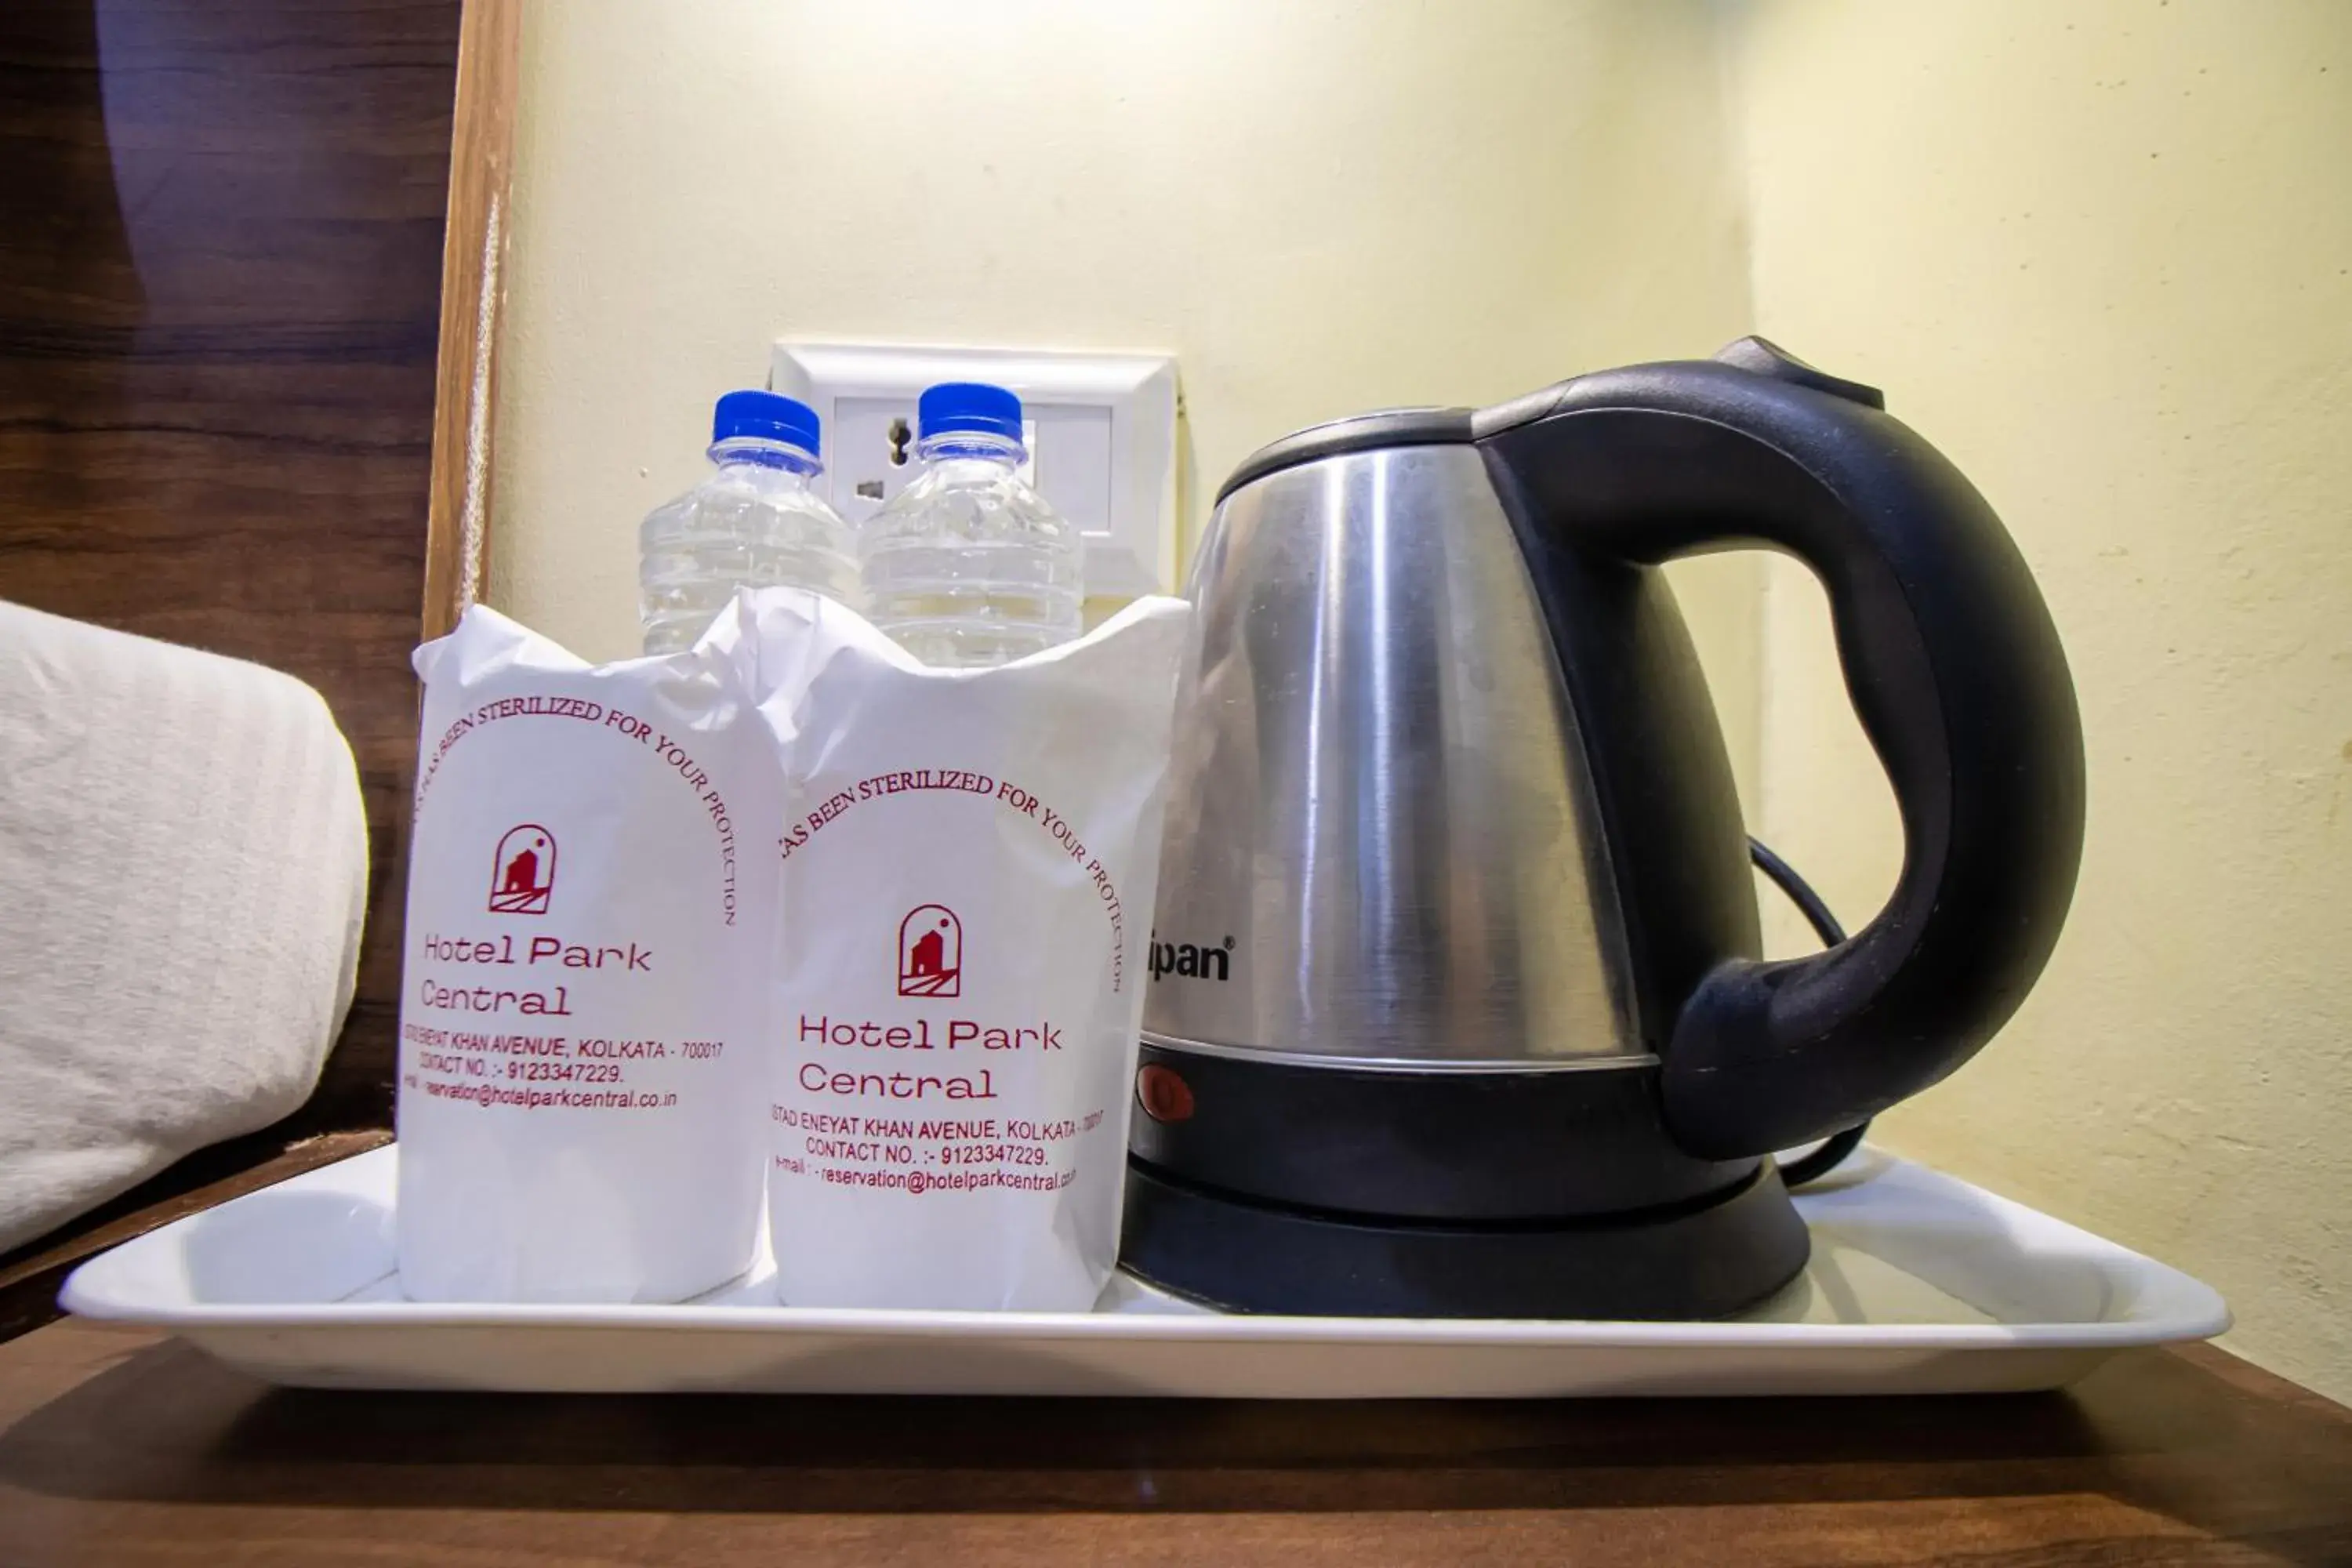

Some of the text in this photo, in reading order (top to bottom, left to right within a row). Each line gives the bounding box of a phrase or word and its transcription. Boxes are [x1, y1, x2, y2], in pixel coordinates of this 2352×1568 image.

[477, 695, 603, 725] STERILIZED
[604, 709, 653, 745] FOR
[655, 735, 709, 792] YOUR
[702, 790, 736, 927] PROTECTION
[807, 786, 857, 832] BEEN
[858, 769, 994, 800] STERILIZED
[996, 781, 1040, 818] FOR
[1040, 807, 1087, 864] YOUR
[423, 933, 652, 972] Hotel Park
[420, 978, 574, 1016] Central
[490, 1033, 570, 1058] AVENUE,
[577, 1038, 666, 1059] KOLKATA
[681, 1041, 724, 1059] 700017
[800, 1014, 1064, 1051] Hotel Park
[507, 1060, 625, 1083] 9123347229.
[799, 1063, 998, 1099] Central
[800, 1112, 859, 1135] ENEYAT
[864, 1118, 913, 1138] KHAN
[918, 1119, 1000, 1140] AVENUE,
[1007, 1119, 1076, 1141] KOLKATA
[805, 1136, 880, 1162] CONTACT
[885, 1145, 916, 1165] NO.
[941, 1145, 1049, 1167] 9123347229.
